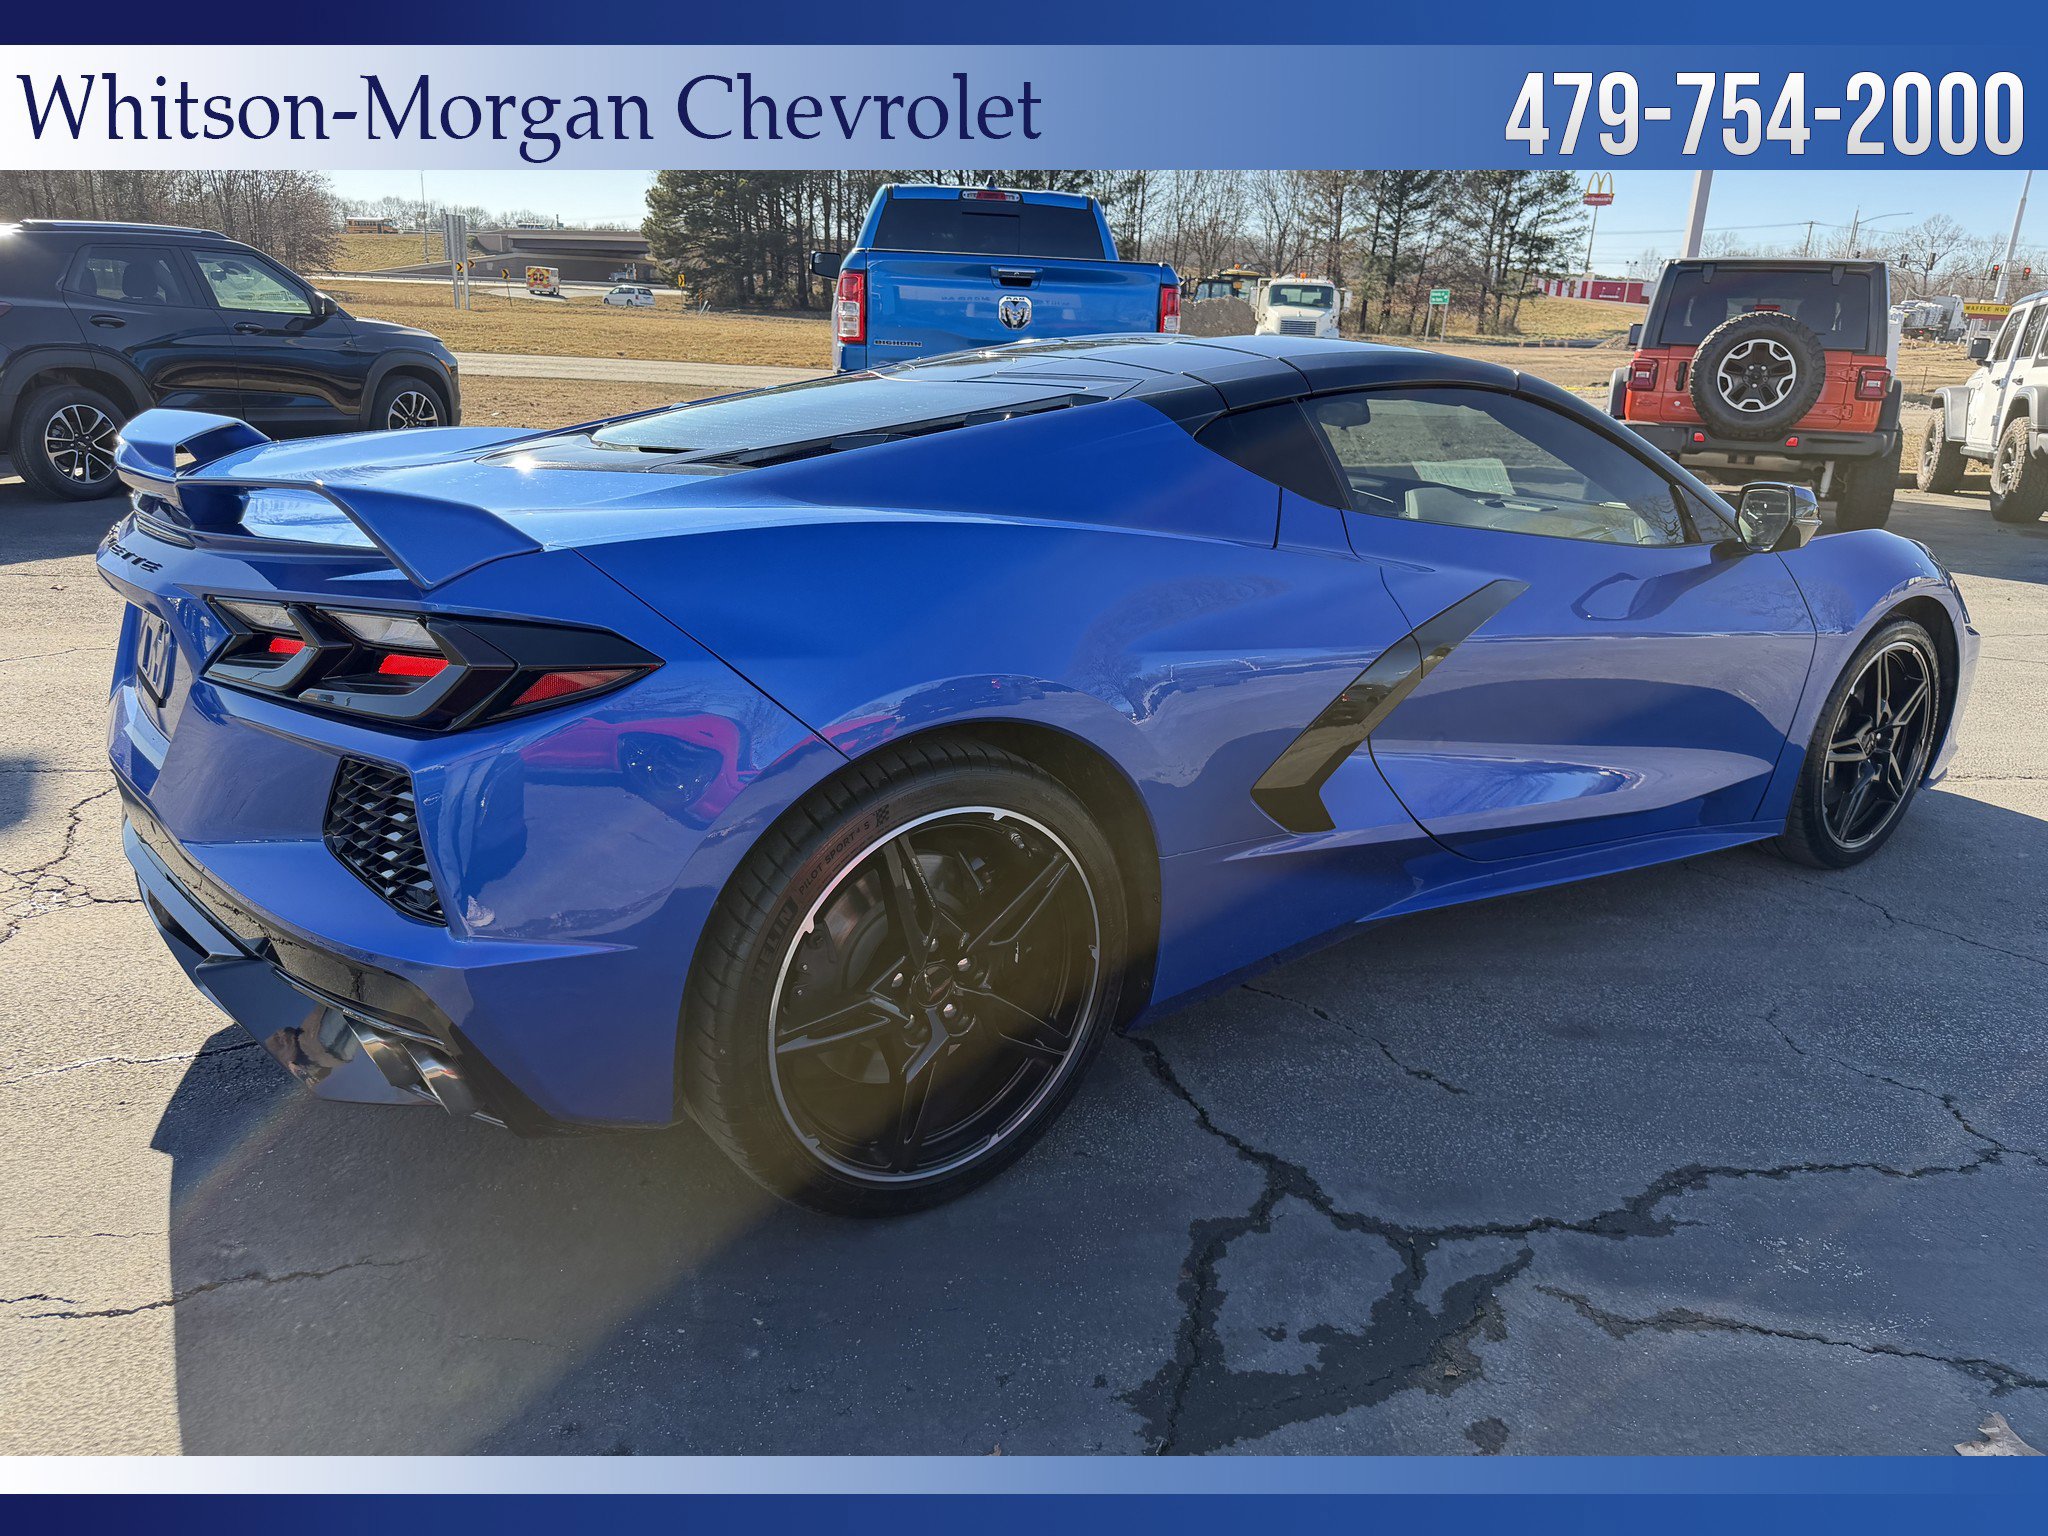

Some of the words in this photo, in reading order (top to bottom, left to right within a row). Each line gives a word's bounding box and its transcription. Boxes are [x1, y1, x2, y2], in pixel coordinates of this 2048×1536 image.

[875, 339, 922, 347] BIGHORN
[799, 864, 824, 895] PILOT
[824, 831, 857, 864] SPORT
